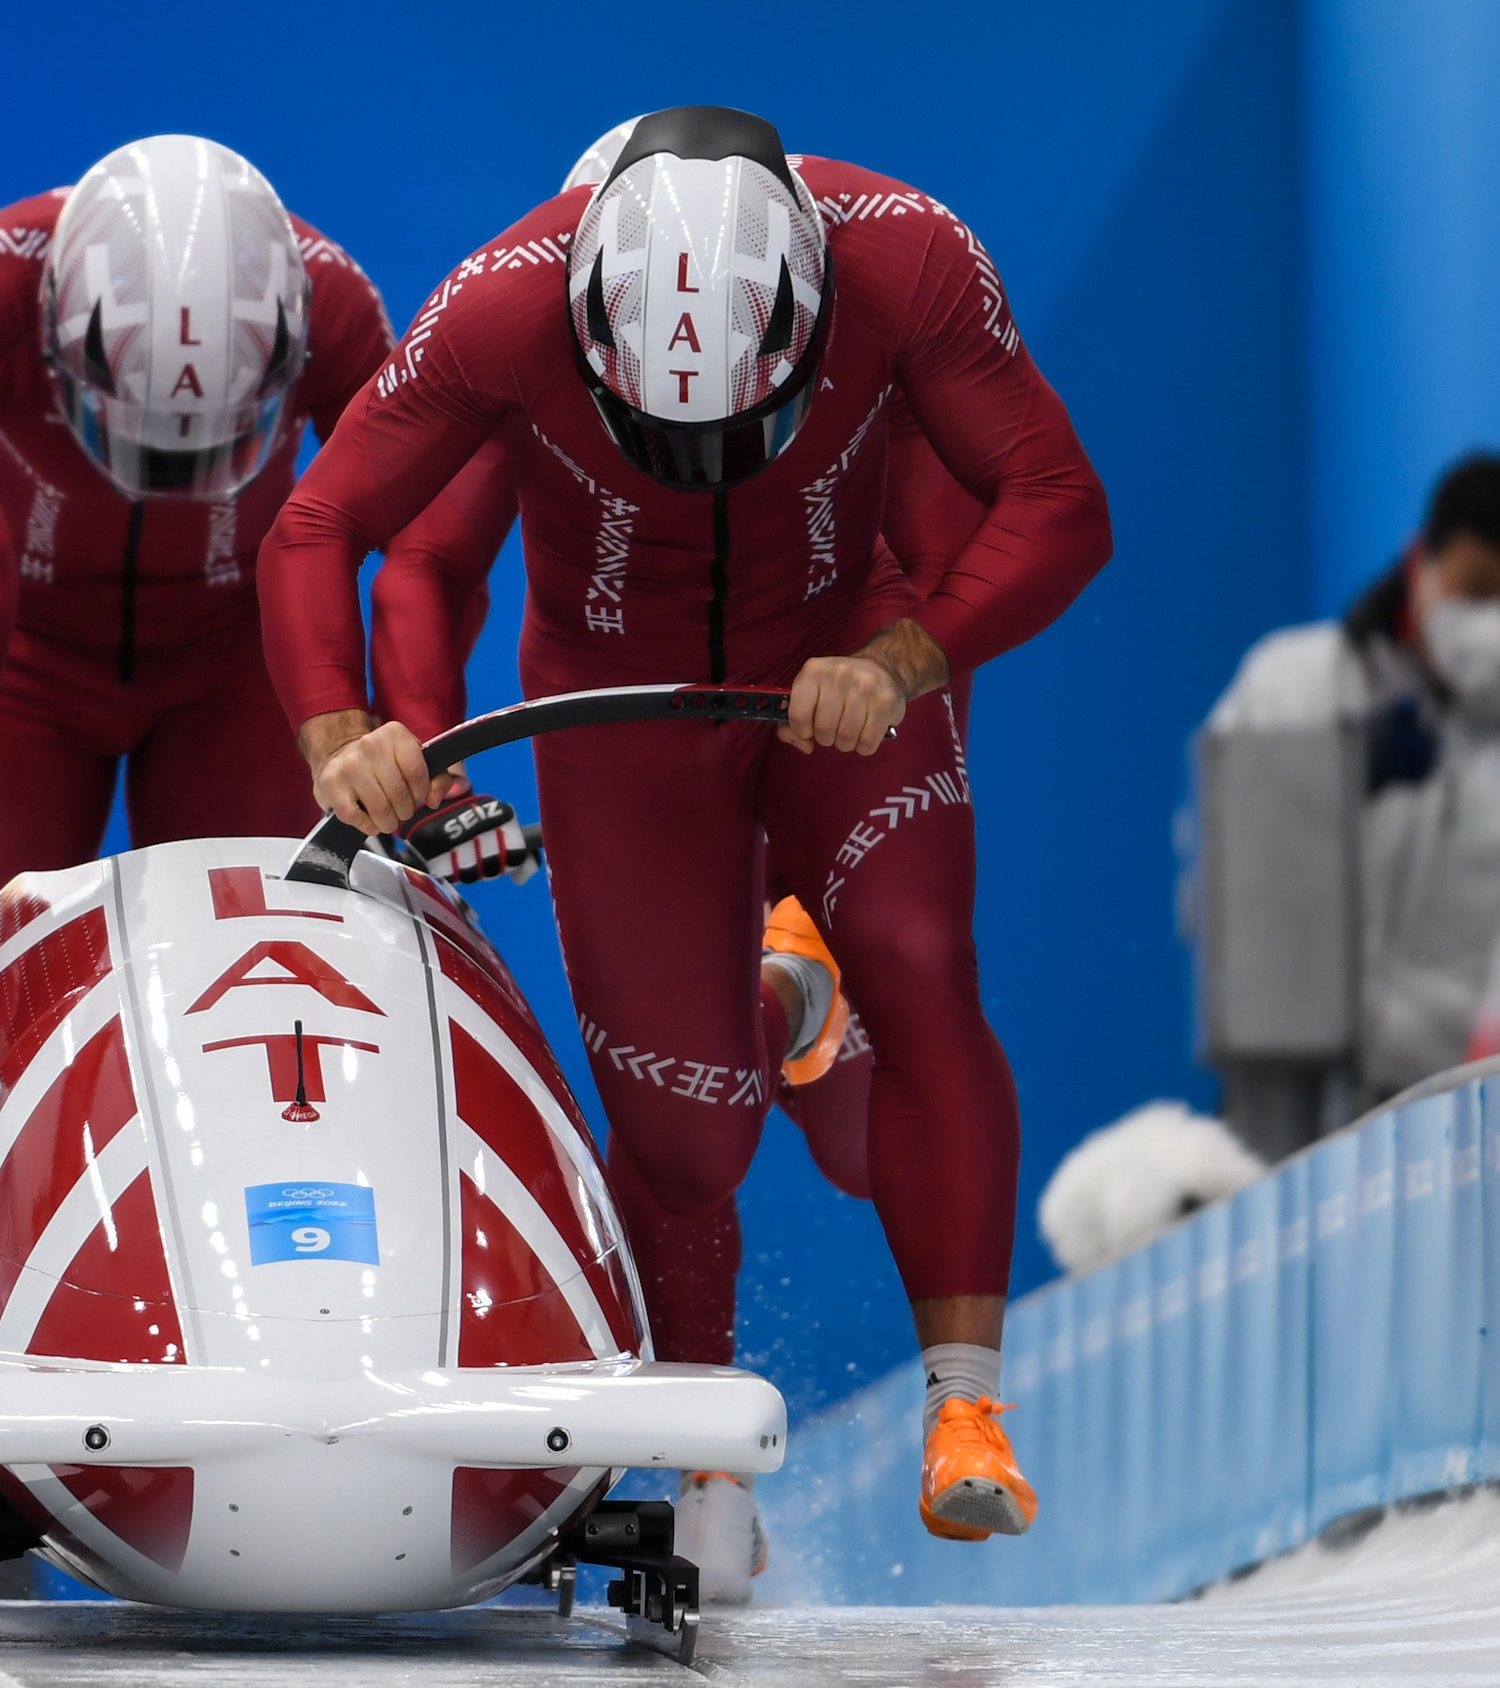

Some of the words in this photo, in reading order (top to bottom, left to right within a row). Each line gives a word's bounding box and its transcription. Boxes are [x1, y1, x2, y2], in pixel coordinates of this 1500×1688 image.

[171, 307, 204, 437] LAT
[668, 253, 702, 403] LAT
[183, 866, 389, 1103] LAT
[268, 1200, 312, 1208] BEIJING
[291, 1227, 331, 1252] 9
